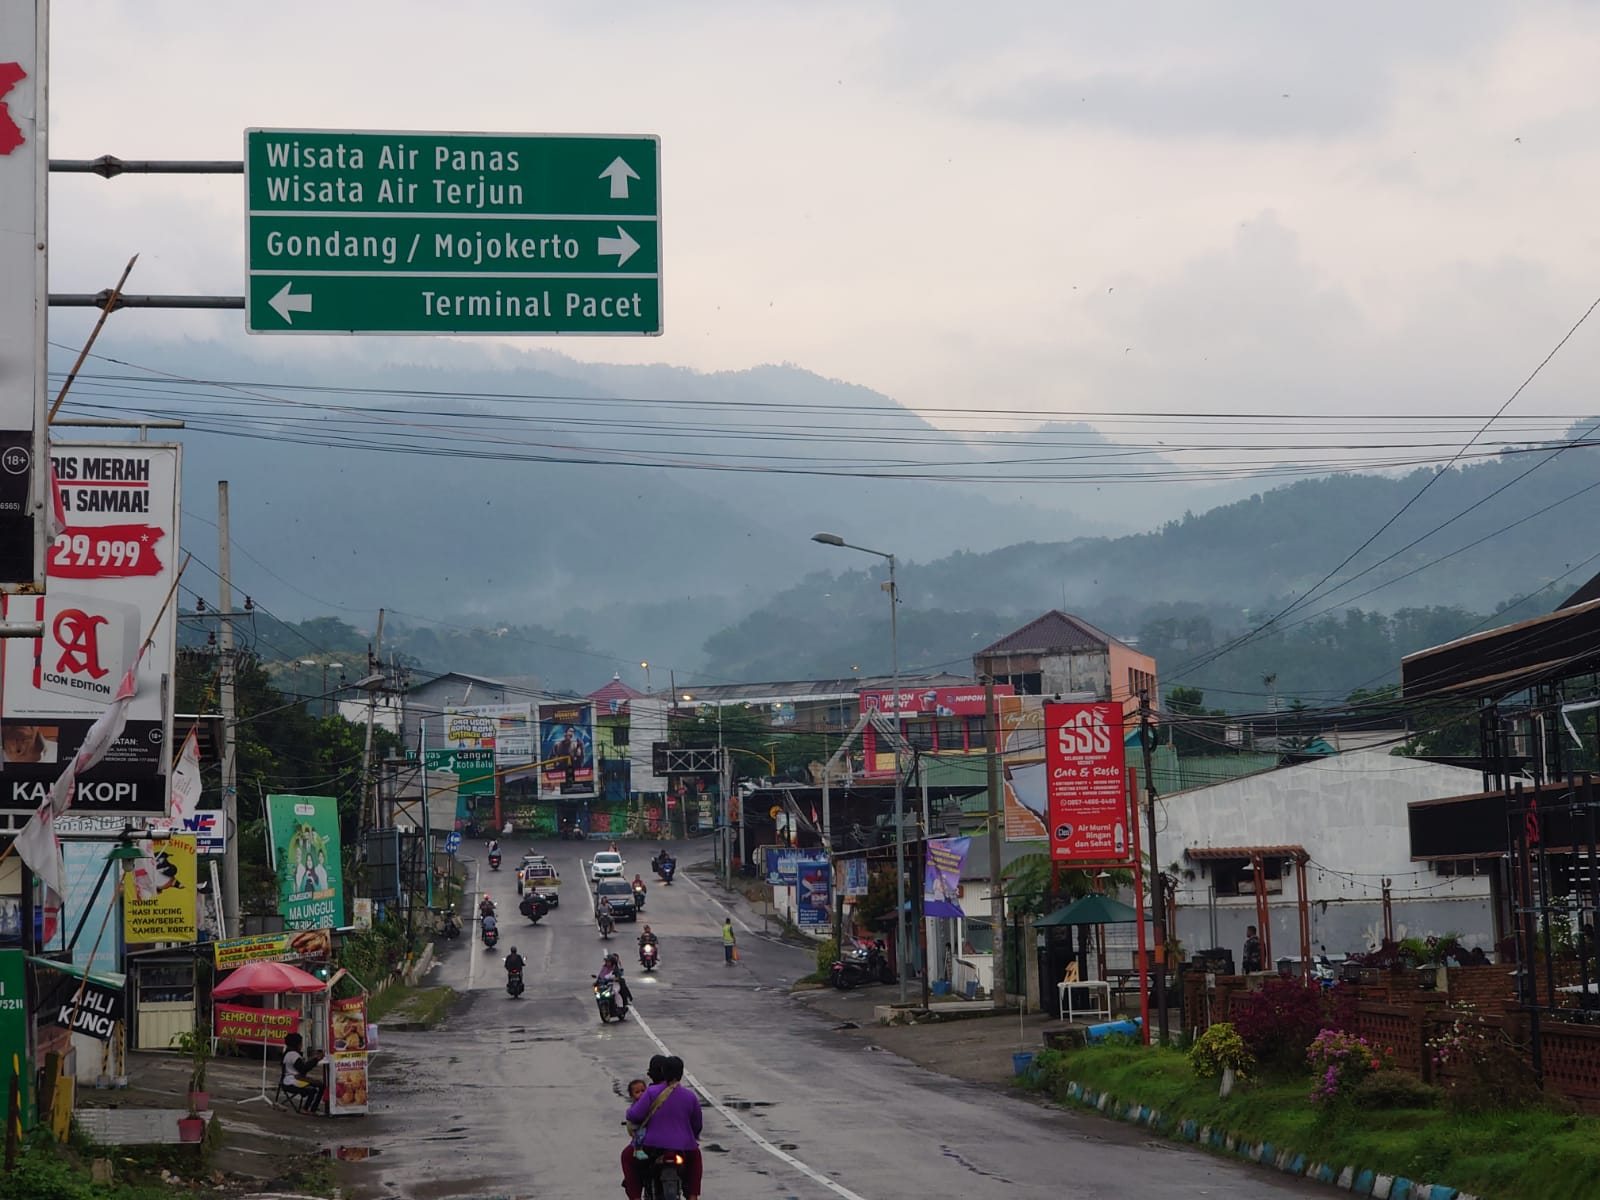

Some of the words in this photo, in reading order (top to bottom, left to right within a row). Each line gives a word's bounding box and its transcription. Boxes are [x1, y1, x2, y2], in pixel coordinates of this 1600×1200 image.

[266, 141, 364, 169] Wisata
[378, 144, 419, 170] Air
[435, 146, 520, 171] Panas
[266, 175, 363, 202] Wisata
[377, 178, 418, 203] Air
[432, 175, 523, 208] Terjun
[266, 231, 397, 264] Gondang
[407, 234, 420, 263] /
[435, 231, 579, 265] Mojokerto
[422, 290, 551, 316] Terminal
[566, 292, 642, 317] Pacet
[6, 456, 26, 465] 18+
[83, 458, 149, 480] MERAH
[77, 490, 149, 512] SAMAA!
[44, 673, 67, 685] ICON
[71, 679, 110, 694] EDITION
[1058, 710, 1110, 754] SSS
[457, 751, 491, 761] Cangar
[1080, 767, 1089, 777] &
[1093, 766, 1119, 777] Resto
[13, 782, 56, 801] KA
[78, 782, 137, 802] KOPI
[168, 839, 196, 855] SHIFU
[1086, 832, 1111, 841] Ringan
[289, 906, 302, 920] MA
[303, 900, 335, 917] UNGGUL
[70, 988, 114, 1014] AHLI
[58, 1005, 115, 1037] KUNCI
[220, 1012, 258, 1023] SEMPOL
[262, 1014, 292, 1025] CILOR
[221, 1026, 251, 1036] AYAM
